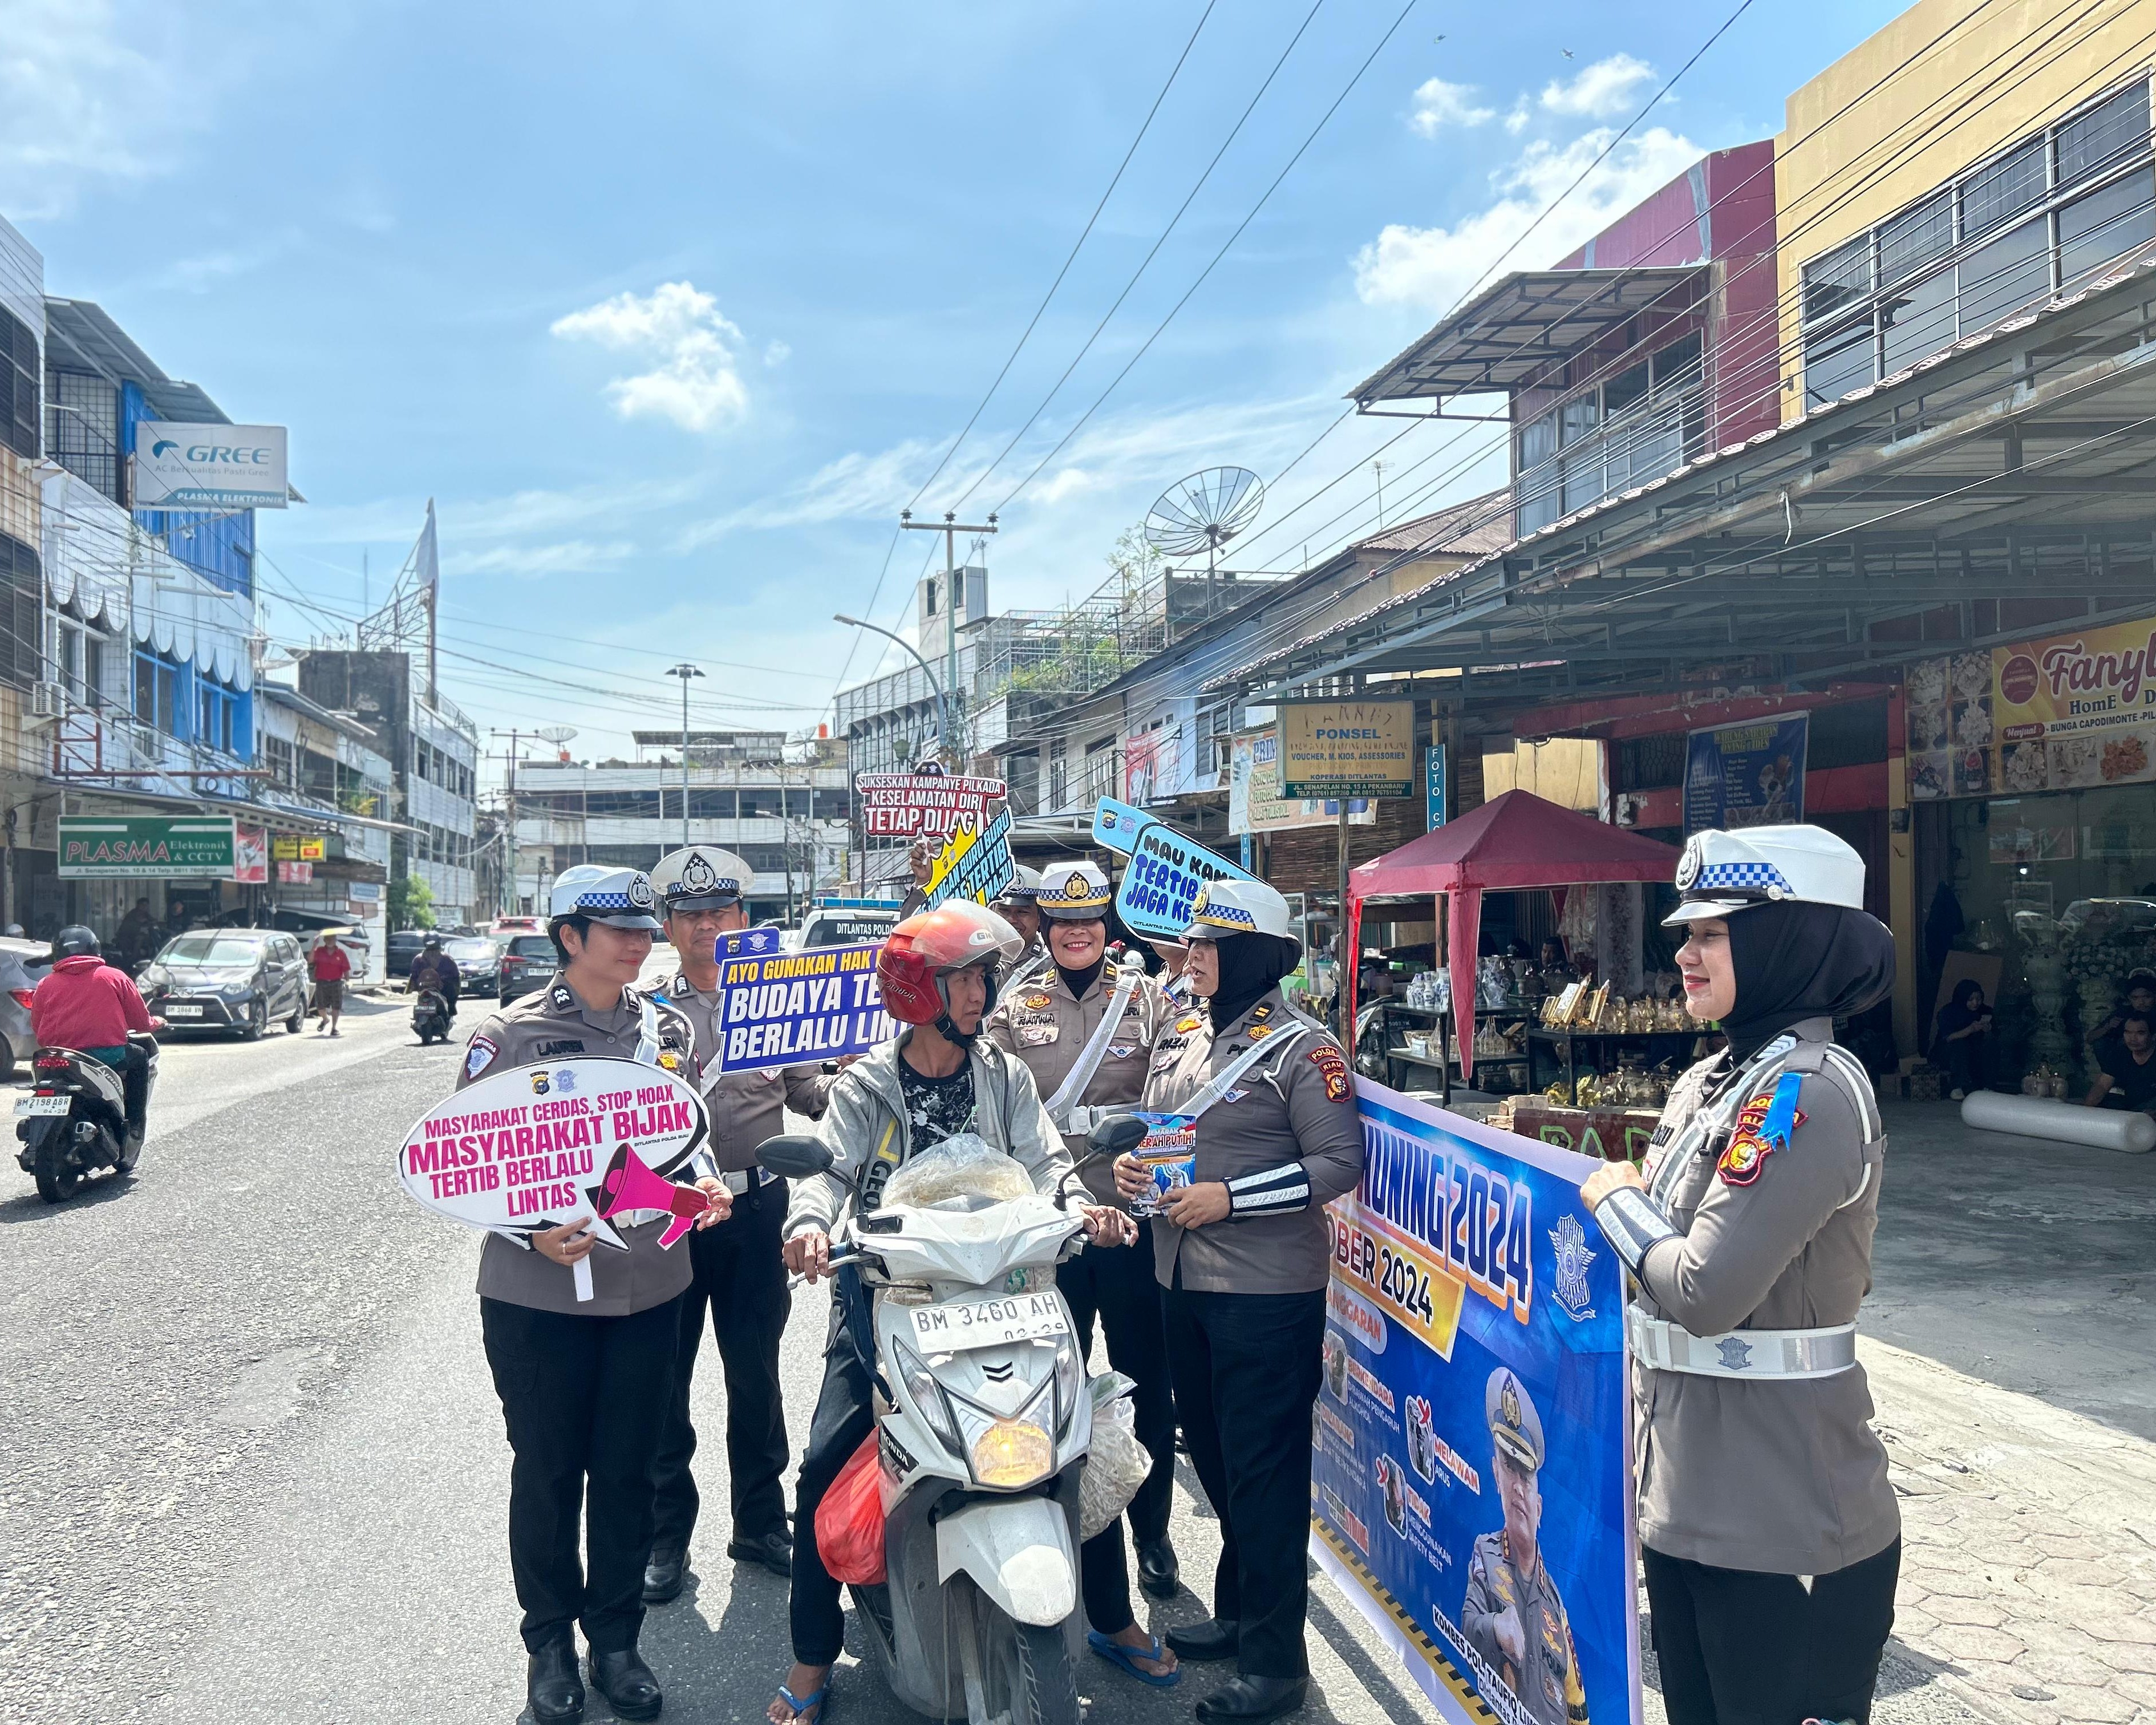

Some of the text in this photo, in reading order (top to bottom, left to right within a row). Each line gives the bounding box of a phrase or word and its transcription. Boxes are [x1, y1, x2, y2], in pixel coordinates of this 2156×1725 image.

[187, 445, 272, 465] GREE
[171, 465, 221, 475] Berkualitas
[224, 467, 245, 476] Pasti
[248, 468, 269, 477] Gree
[177, 492, 285, 504] PLASMA ELEKTRONIK
[1316, 728, 1381, 740] PONSEL
[2050, 719, 2078, 733] BUNGA
[2079, 712, 2138, 729] CAPODIMONTE
[1291, 752, 1327, 762] VOUCHER,
[1338, 752, 1357, 761] KIOS,
[1358, 752, 1406, 760] ASSESSORIES
[858, 776, 1001, 794] SUKSESKAN KAMPANYE PILKADA
[871, 790, 983, 811] KESELAMATAN DIRI
[865, 807, 921, 831] TETAP
[66, 840, 228, 863] PLASMA Elektronik
[174, 852, 224, 861] & CCTV
[927, 809, 1010, 912] JANGAN BURU BURU
[1144, 835, 1185, 867] MAU
[968, 837, 1007, 892] TERTIB
[984, 858, 1014, 902] MAJU
[1135, 853, 1198, 901] TERTIB
[1125, 882, 1194, 924] JAGA KE
[837, 923, 872, 935] DITLANTAS
[1133, 920, 1163, 930] DITLANTAS
[727, 962, 759, 985] AYO
[763, 954, 836, 980] GUNAKAN
[840, 949, 872, 973] HAK
[727, 976, 843, 1023] BUDAYA
[1017, 1013, 1055, 1026] RATNA
[727, 1014, 849, 1062] BERLALU
[1311, 1047, 1338, 1060] POLDA
[1322, 1062, 1342, 1071] RIAU
[29, 1098, 51, 1107] 2198
[425, 1083, 675, 1139] MASYARAKAT CERDAS, STOP HOAX
[407, 1101, 694, 1175] MASYARAKAT BIJAK
[1140, 1133, 1193, 1148] ERAH PUTIH
[429, 1148, 594, 1200] TERTIB BERLALU
[506, 1181, 578, 1217] LINTAS
[1448, 1164, 1530, 1306] 2024
[1380, 1247, 1432, 1324] 2024
[917, 1295, 1060, 1333] BM 3460 AH
[1434, 1437, 1478, 1491] MELAWAN
[1435, 1465, 1451, 1488] ARUS
[1433, 1608, 1465, 1654] KOMBES
[1486, 1667, 1517, 1716] TAUFIQ
